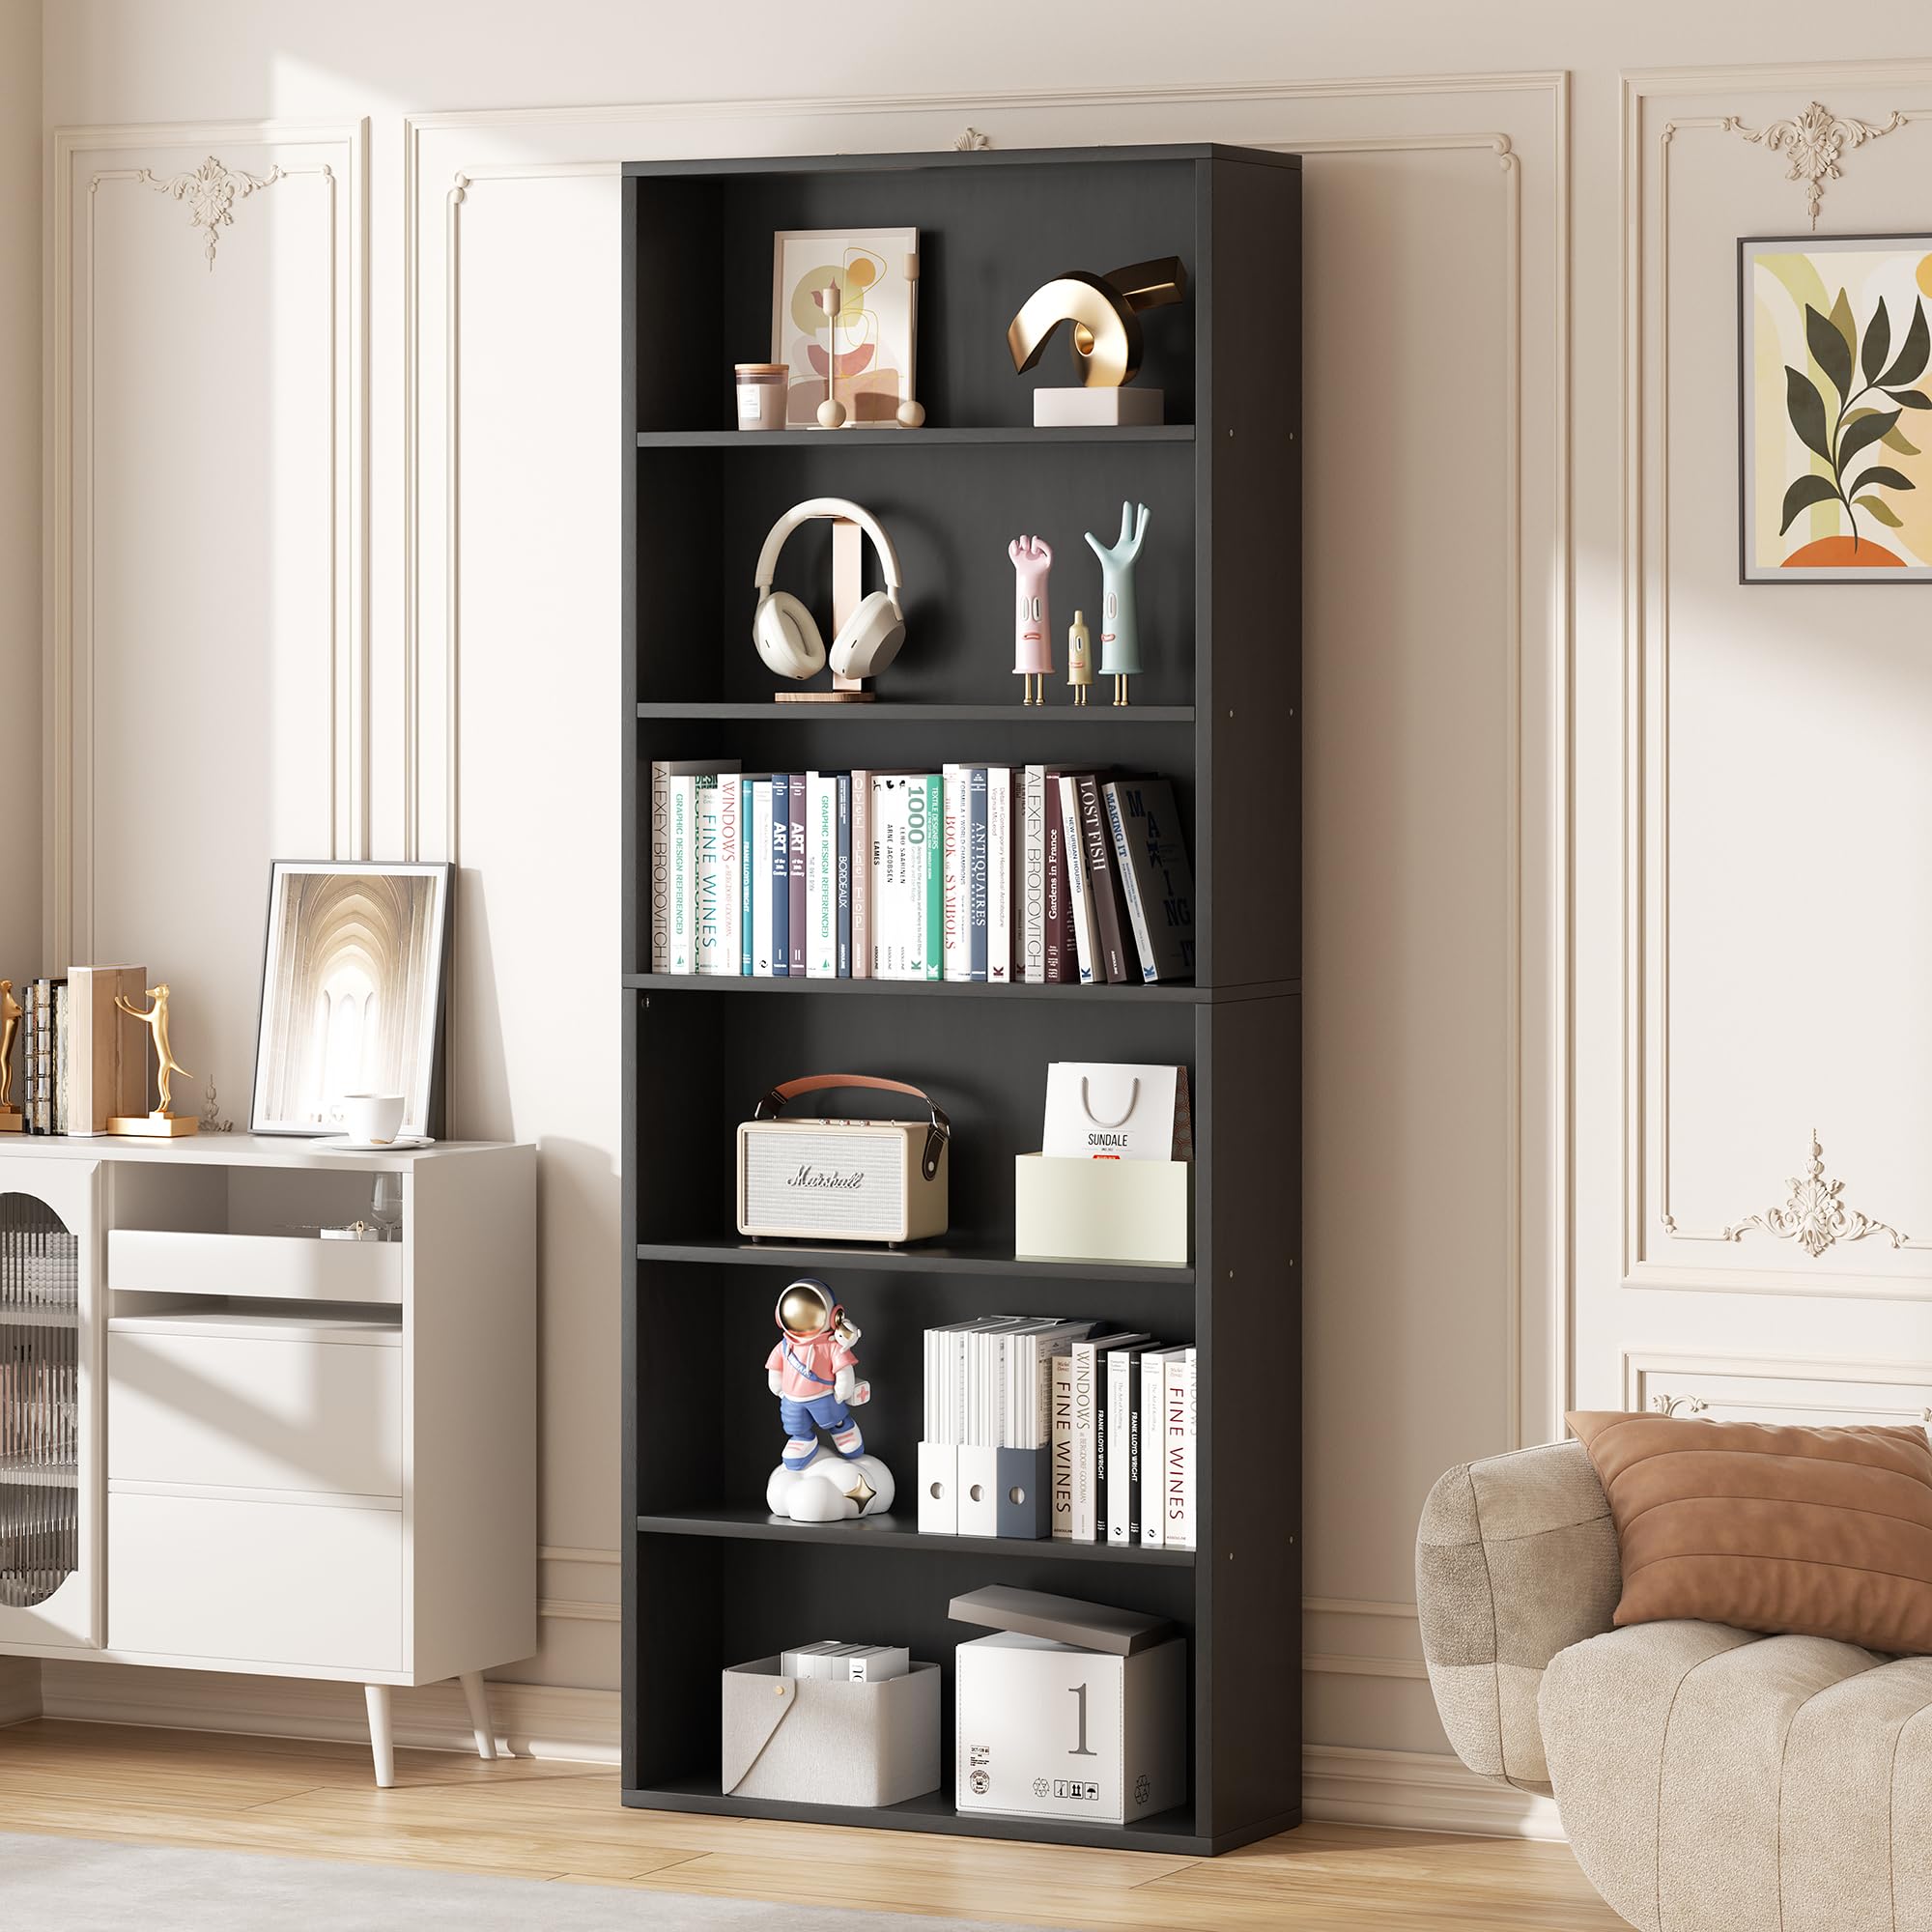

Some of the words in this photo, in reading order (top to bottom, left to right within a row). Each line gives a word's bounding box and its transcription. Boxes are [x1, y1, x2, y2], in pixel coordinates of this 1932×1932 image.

[654, 767, 668, 838] ALEXEY
[722, 781, 735, 862] WINDOWS
[908, 786, 925, 844] 1000
[1028, 771, 1041, 842] ALEXEY
[1080, 780, 1099, 827] LOST
[1105, 792, 1123, 842] MAKING
[1118, 844, 1127, 858] IT
[702, 814, 717, 864] FINE
[774, 822, 786, 854] ART
[792, 822, 805, 854] ART
[946, 816, 956, 858] BOOK
[1048, 829, 1058, 864] France
[1088, 830, 1106, 870] FISH
[838, 856, 847, 909] BORDEAUX
[975, 822, 986, 926] ANTIQUAIRES
[1048, 866, 1058, 876] in
[1073, 860, 1082, 894] HOUSING
[654, 842, 668, 958] BRODOVITCH
[702, 875, 717, 949] WINES
[946, 874, 956, 950] SYMBOLS
[1028, 848, 1041, 967] BRODOVITCH
[1048, 878, 1058, 920] Gardens
[1088, 1133, 1128, 1147] SUNDALE
[787, 1164, 865, 1190] Marshall
[1056, 1381, 1071, 1430] FINE
[1077, 1350, 1091, 1430] WINDOWS
[1169, 1387, 1184, 1437] FINE
[1056, 1440, 1071, 1514] WINES
[1169, 1447, 1184, 1520] WINES
[1067, 1682, 1097, 1756] 1
